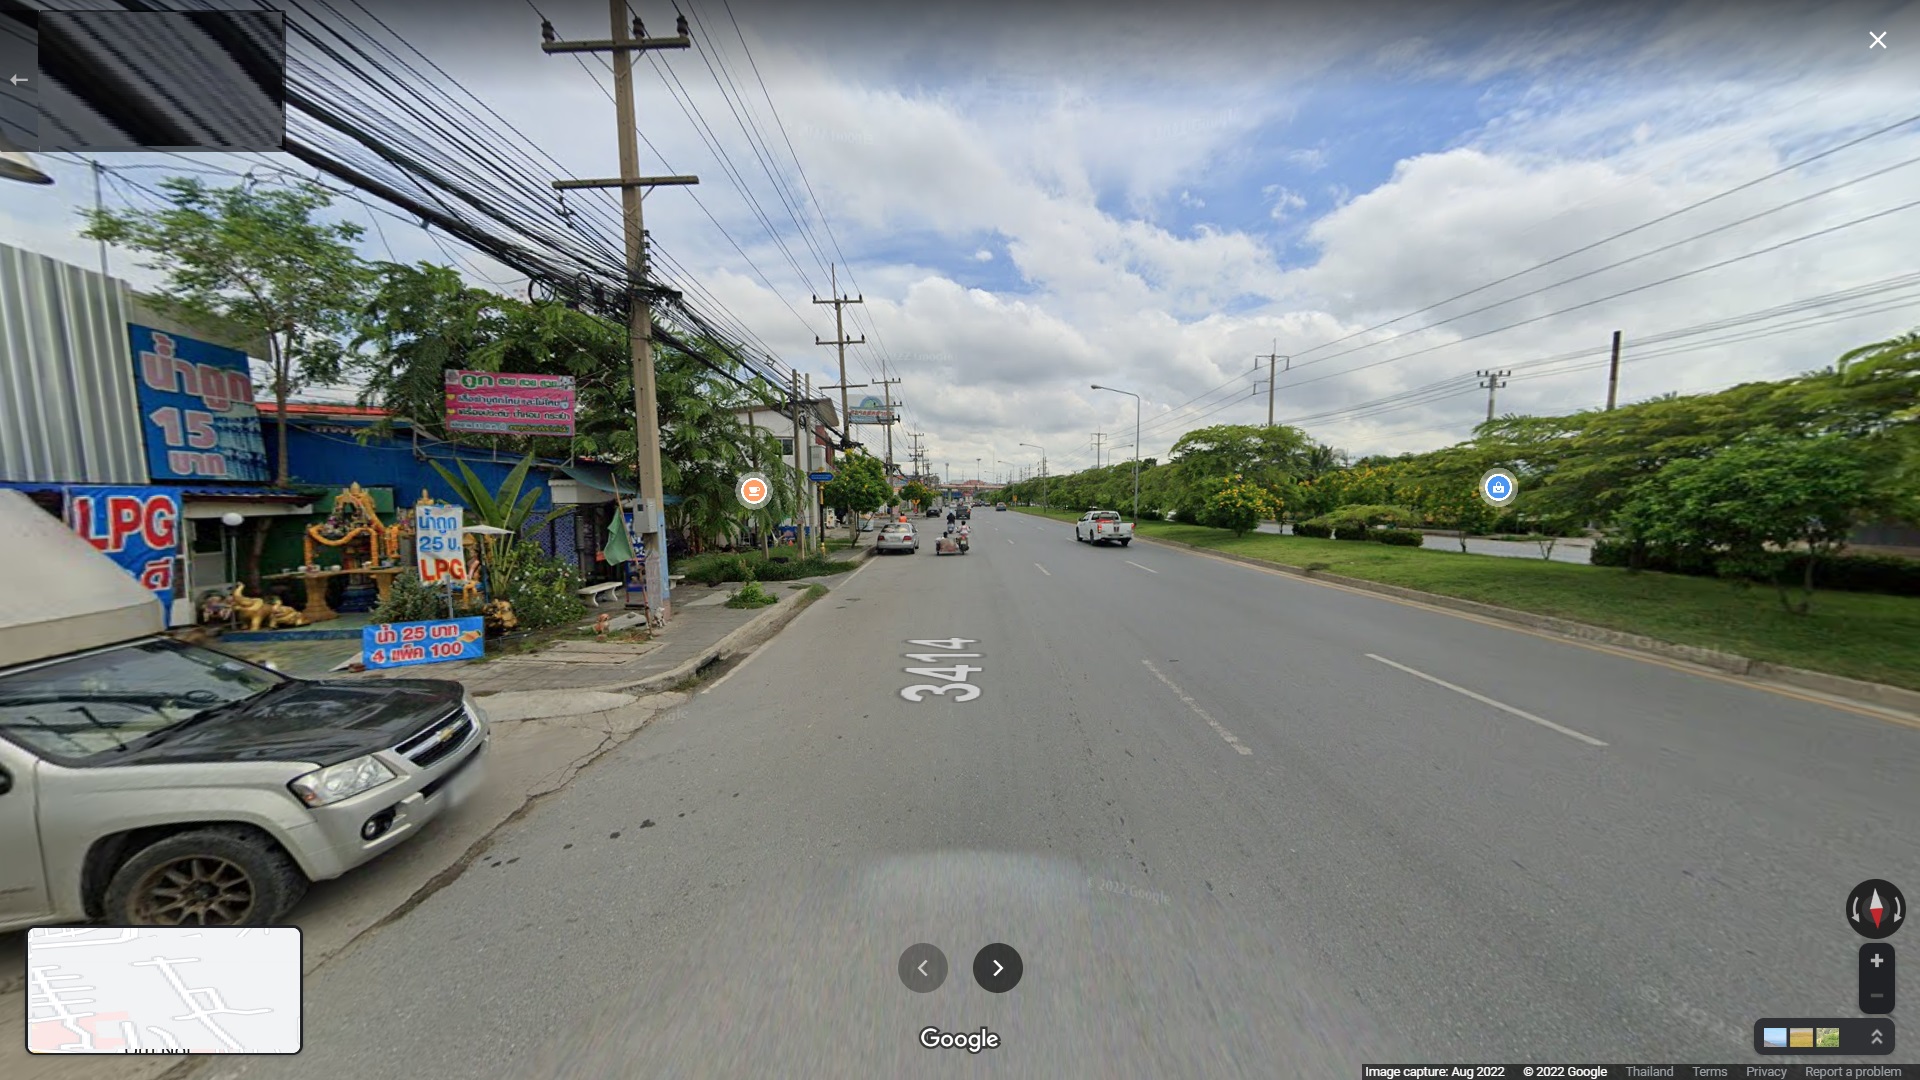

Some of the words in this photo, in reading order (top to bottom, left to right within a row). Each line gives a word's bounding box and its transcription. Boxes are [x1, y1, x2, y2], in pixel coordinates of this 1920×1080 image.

[461, 374, 494, 389] ถูก
[150, 406, 218, 449] 15
[168, 450, 227, 475] บาท
[74, 495, 177, 552] LPG
[418, 508, 458, 534] น้ำถูก
[419, 535, 444, 551] 25
[420, 558, 466, 582] LPG
[377, 623, 396, 644] น้ำ
[402, 625, 425, 641] 25
[431, 624, 459, 639] บาท
[371, 649, 386, 664] 4
[430, 641, 463, 657] 100
